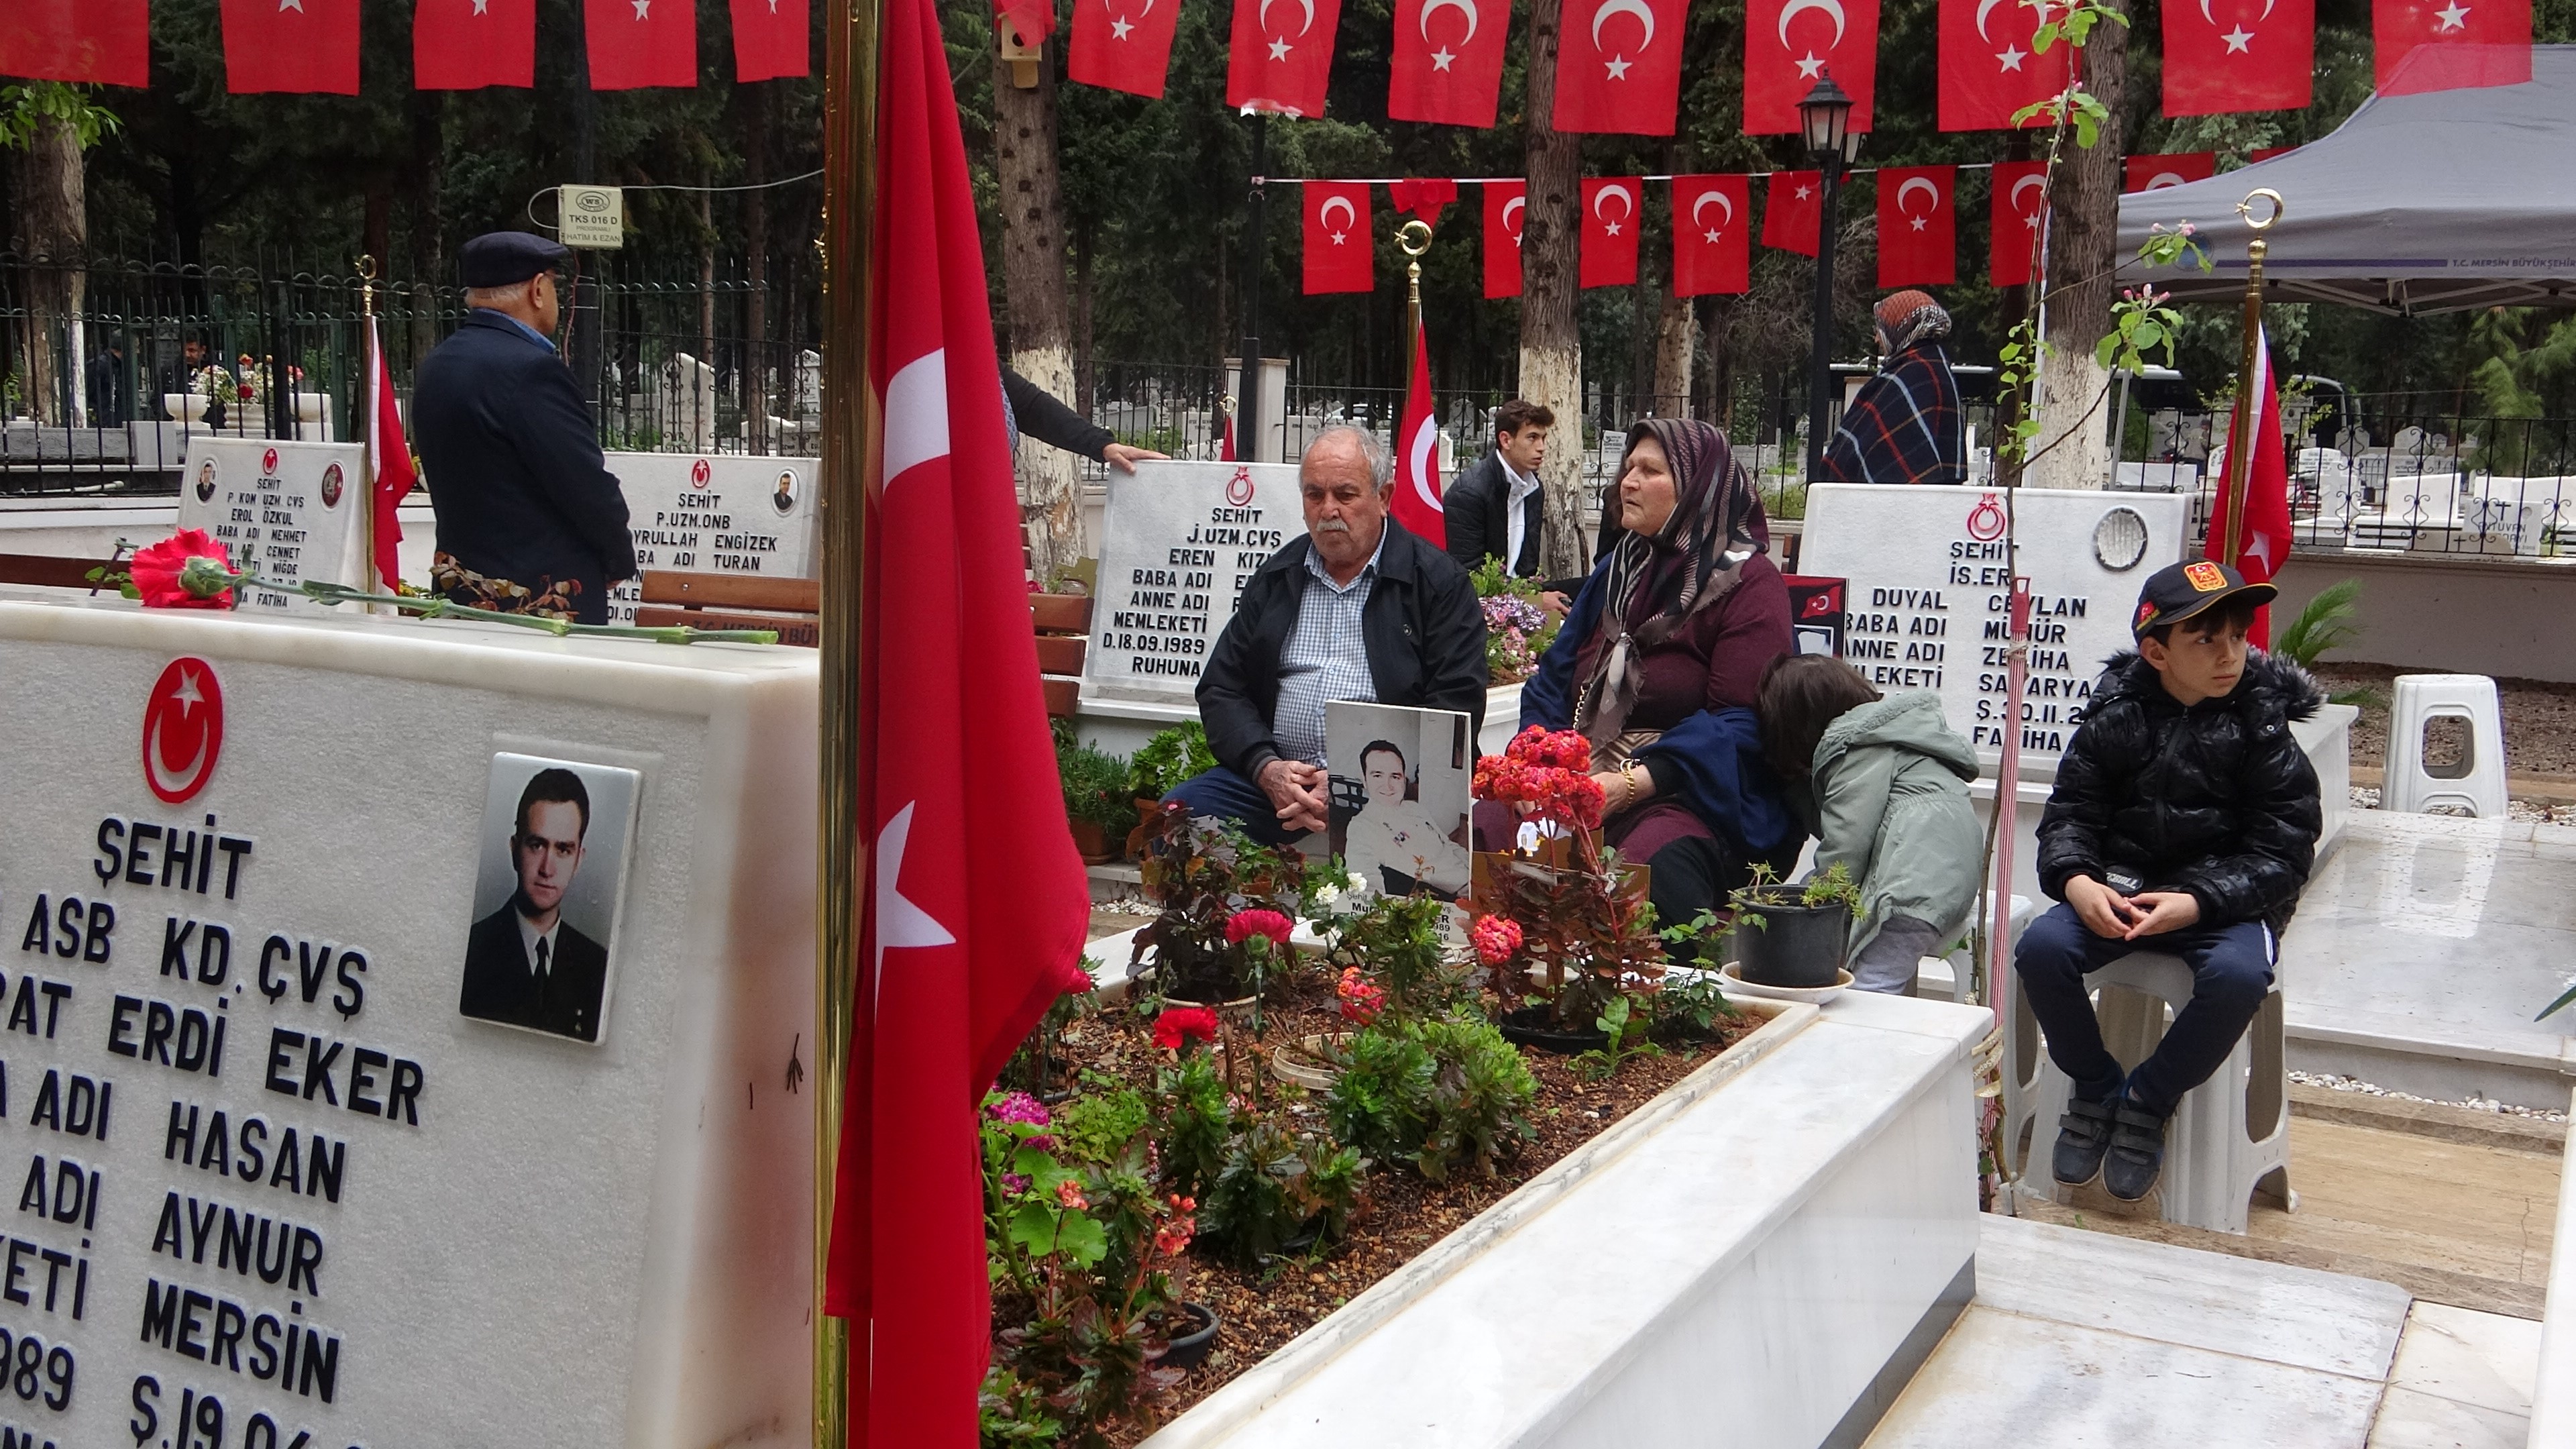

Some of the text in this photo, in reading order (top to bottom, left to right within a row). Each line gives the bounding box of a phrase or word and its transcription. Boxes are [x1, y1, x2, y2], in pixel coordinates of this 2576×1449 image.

[569, 215, 618, 225] TKS 016 D
[2471, 258, 2509, 267] MERSİN
[231, 506, 293, 525] EROL ÖZKUL
[1212, 506, 1263, 523] ŞEHİT
[217, 525, 307, 543] BABA ADI MEHMET
[634, 529, 778, 552] YRULLAH ENGİZEK
[267, 545, 301, 559] CENNET
[637, 549, 761, 570] BA ADI TURAN
[1169, 548, 1215, 567] EREN
[272, 559, 298, 575] NİĞDE
[1133, 570, 1212, 588] BABA ADI
[257, 591, 288, 607] FATİHA
[1130, 591, 1210, 611] ANNE ADI
[1872, 588, 1948, 609] DUYAL
[1114, 611, 1208, 633] MEMLEKETİ
[1909, 617, 1947, 636] ADI
[1103, 633, 1205, 655] D.18.09.1989
[1906, 643, 1943, 661] ADI
[1132, 657, 1201, 678] RUHUNA
[1980, 674, 2091, 699] SAARYA
[1974, 725, 2061, 752] FAİHA
[95, 814, 253, 900] ŞEHİT
[21, 894, 115, 963] ASB
[0, 971, 423, 1126] AT ERDİ EKER
[30, 1069, 112, 1140] ADI
[164, 1102, 345, 1204] HASAN
[19, 1155, 323, 1297] ADI AYNUR
[0, 1236, 339, 1404] ETİ MERSİN
